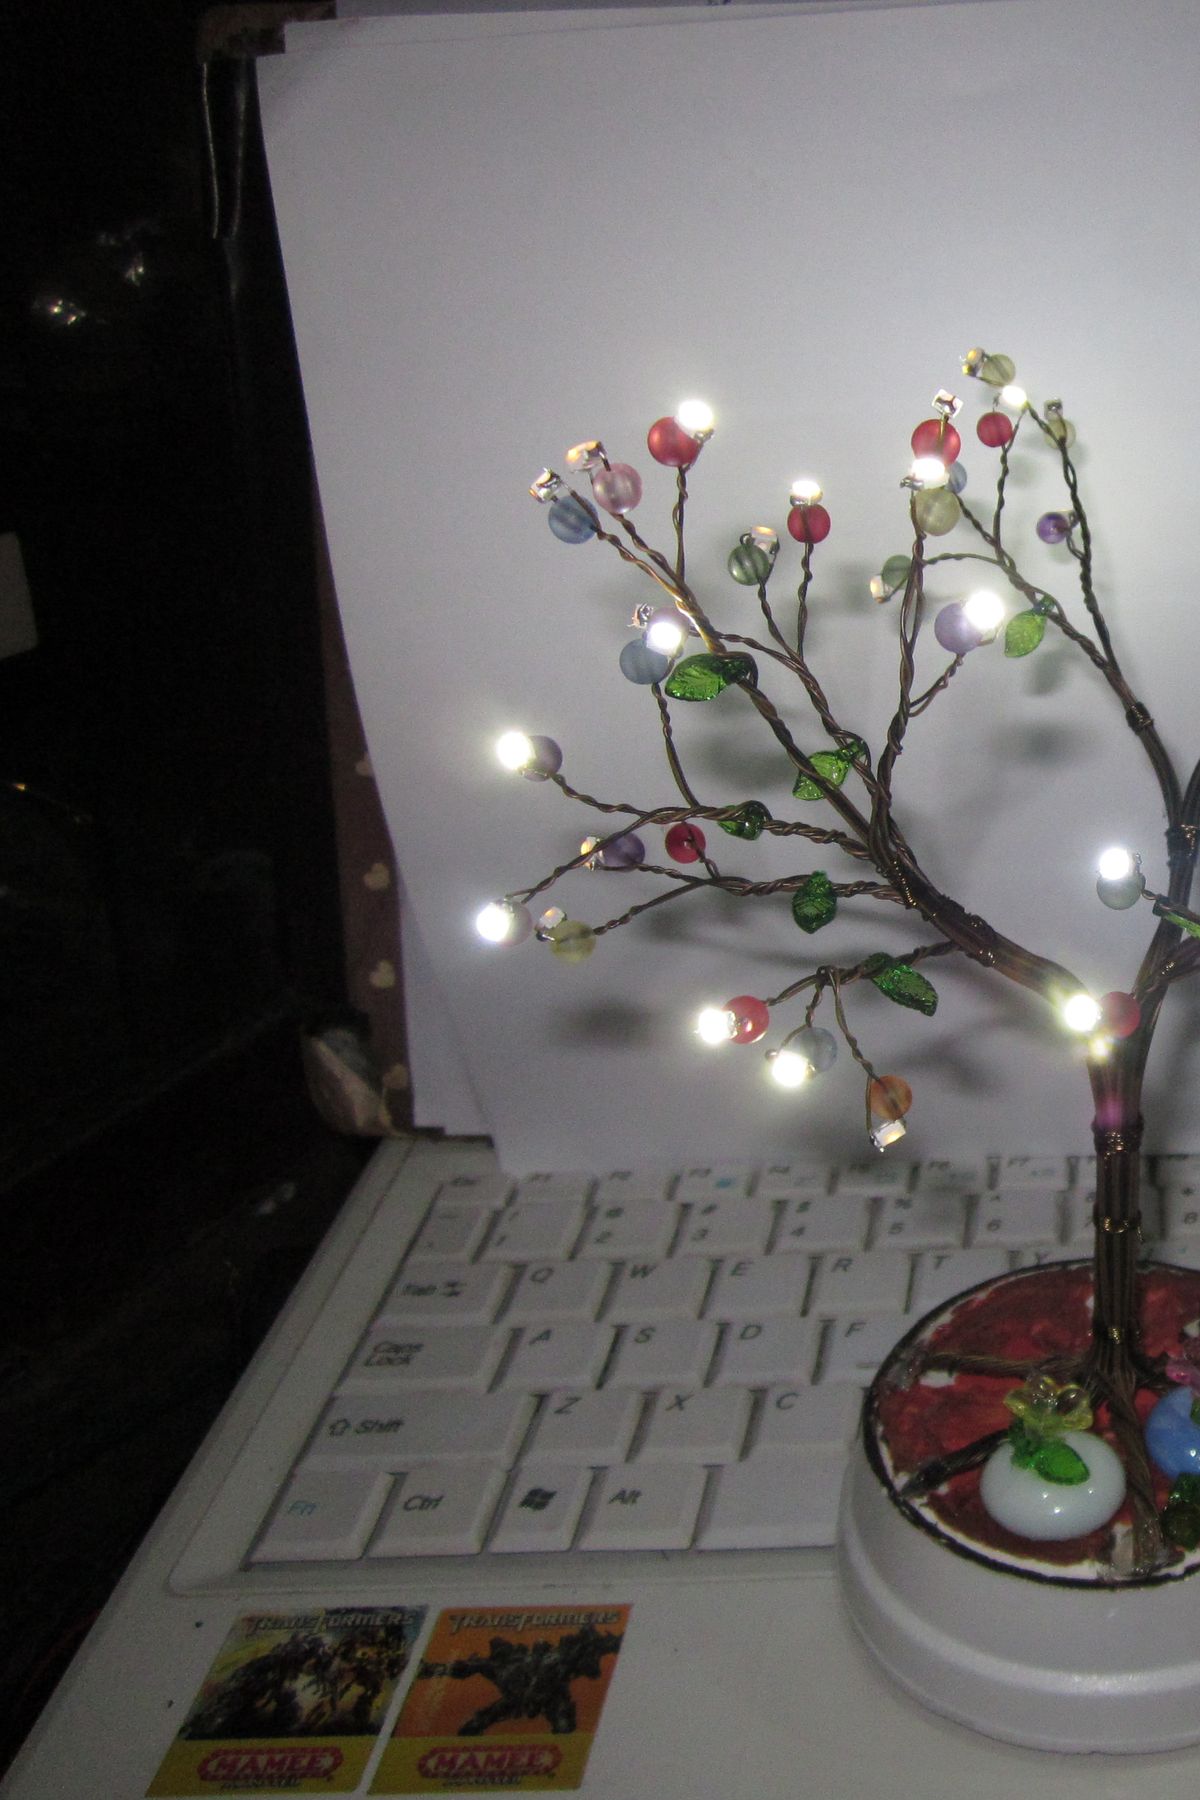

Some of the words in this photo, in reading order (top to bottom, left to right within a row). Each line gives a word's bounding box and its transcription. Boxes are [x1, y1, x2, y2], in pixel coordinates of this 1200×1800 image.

[629, 1263, 657, 1280] W
[729, 1260, 755, 1278] E
[830, 1257, 855, 1274] R
[529, 1266, 555, 1285] Q
[528, 1329, 552, 1346] A
[634, 1326, 656, 1344] S
[739, 1324, 763, 1341] D
[844, 1321, 868, 1338] F
[553, 1396, 584, 1414] Z
[664, 1392, 696, 1412] X
[775, 1392, 801, 1411] C
[353, 1416, 404, 1435] Shift
[402, 1494, 445, 1512] Ctrl
[609, 1488, 644, 1505] Alt
[448, 1610, 618, 1634] TRANSFORMERS
[214, 1754, 328, 1774] MAMEE
[435, 1752, 548, 1771] MAMEE
